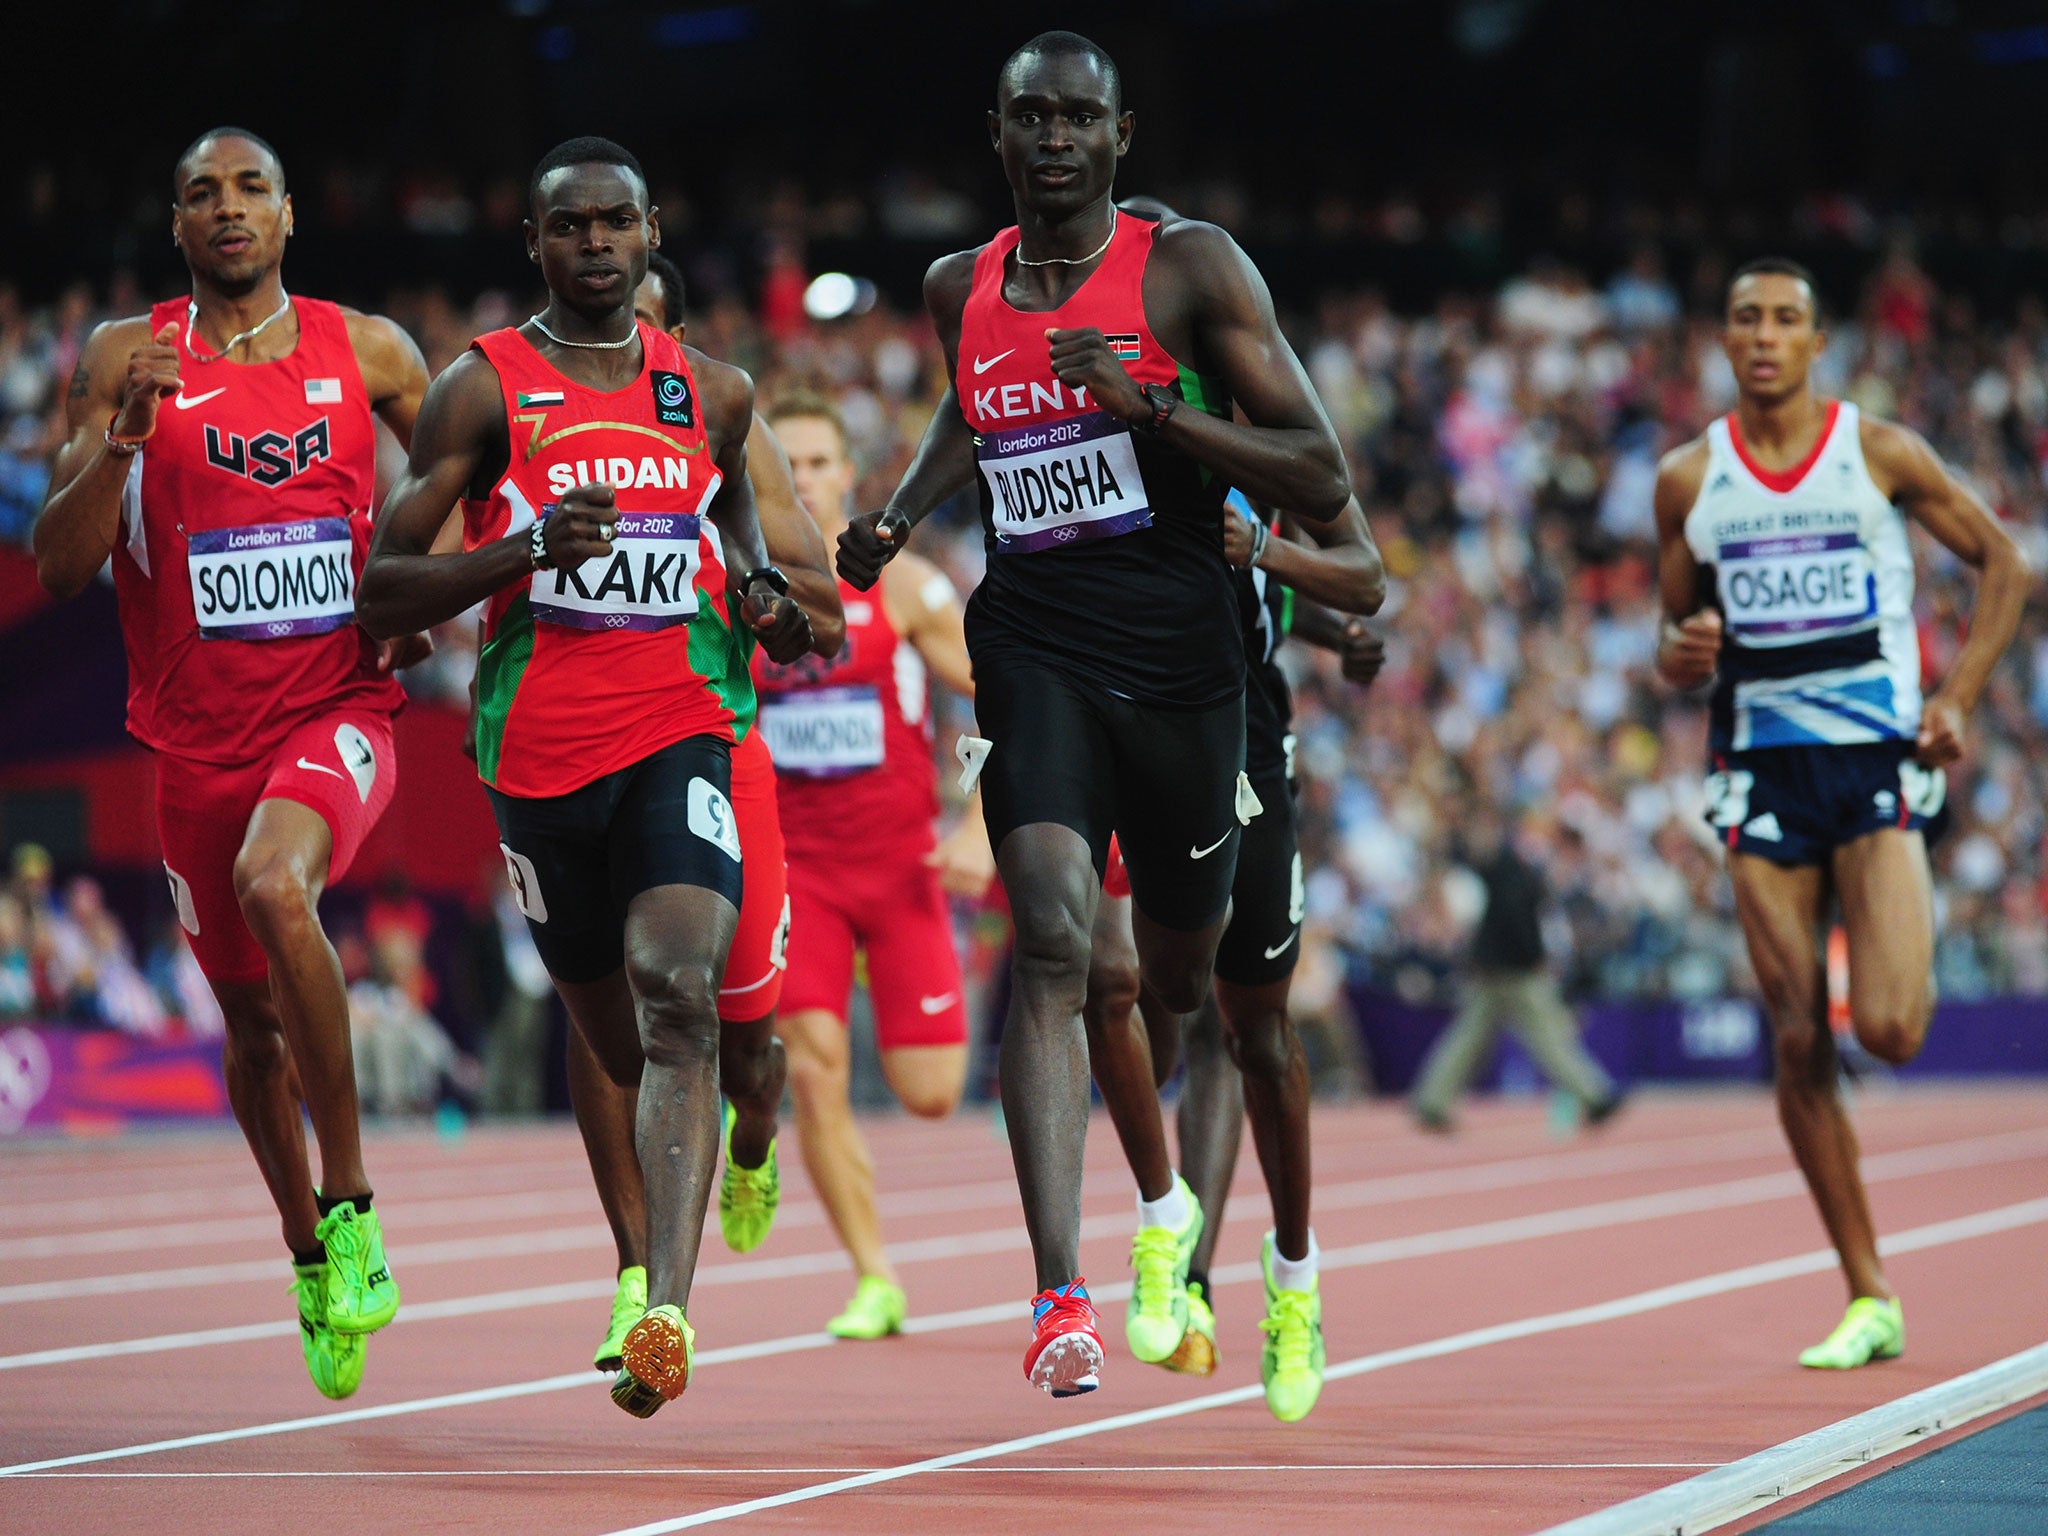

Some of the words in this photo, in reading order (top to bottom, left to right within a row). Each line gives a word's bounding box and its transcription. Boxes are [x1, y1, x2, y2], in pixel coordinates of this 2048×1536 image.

[974, 379, 1098, 420] KENY
[203, 416, 331, 488] USA
[998, 433, 1046, 453] London
[1050, 424, 1081, 442] 2012
[547, 457, 688, 496] SUDAN
[994, 449, 1124, 522] RUDISHA
[228, 528, 281, 548] London
[284, 524, 316, 542] 2012
[642, 518, 674, 534] 2012
[199, 553, 349, 615] SOLOMON
[554, 550, 687, 604] KAKI
[1730, 563, 1855, 608] OSAGIE
